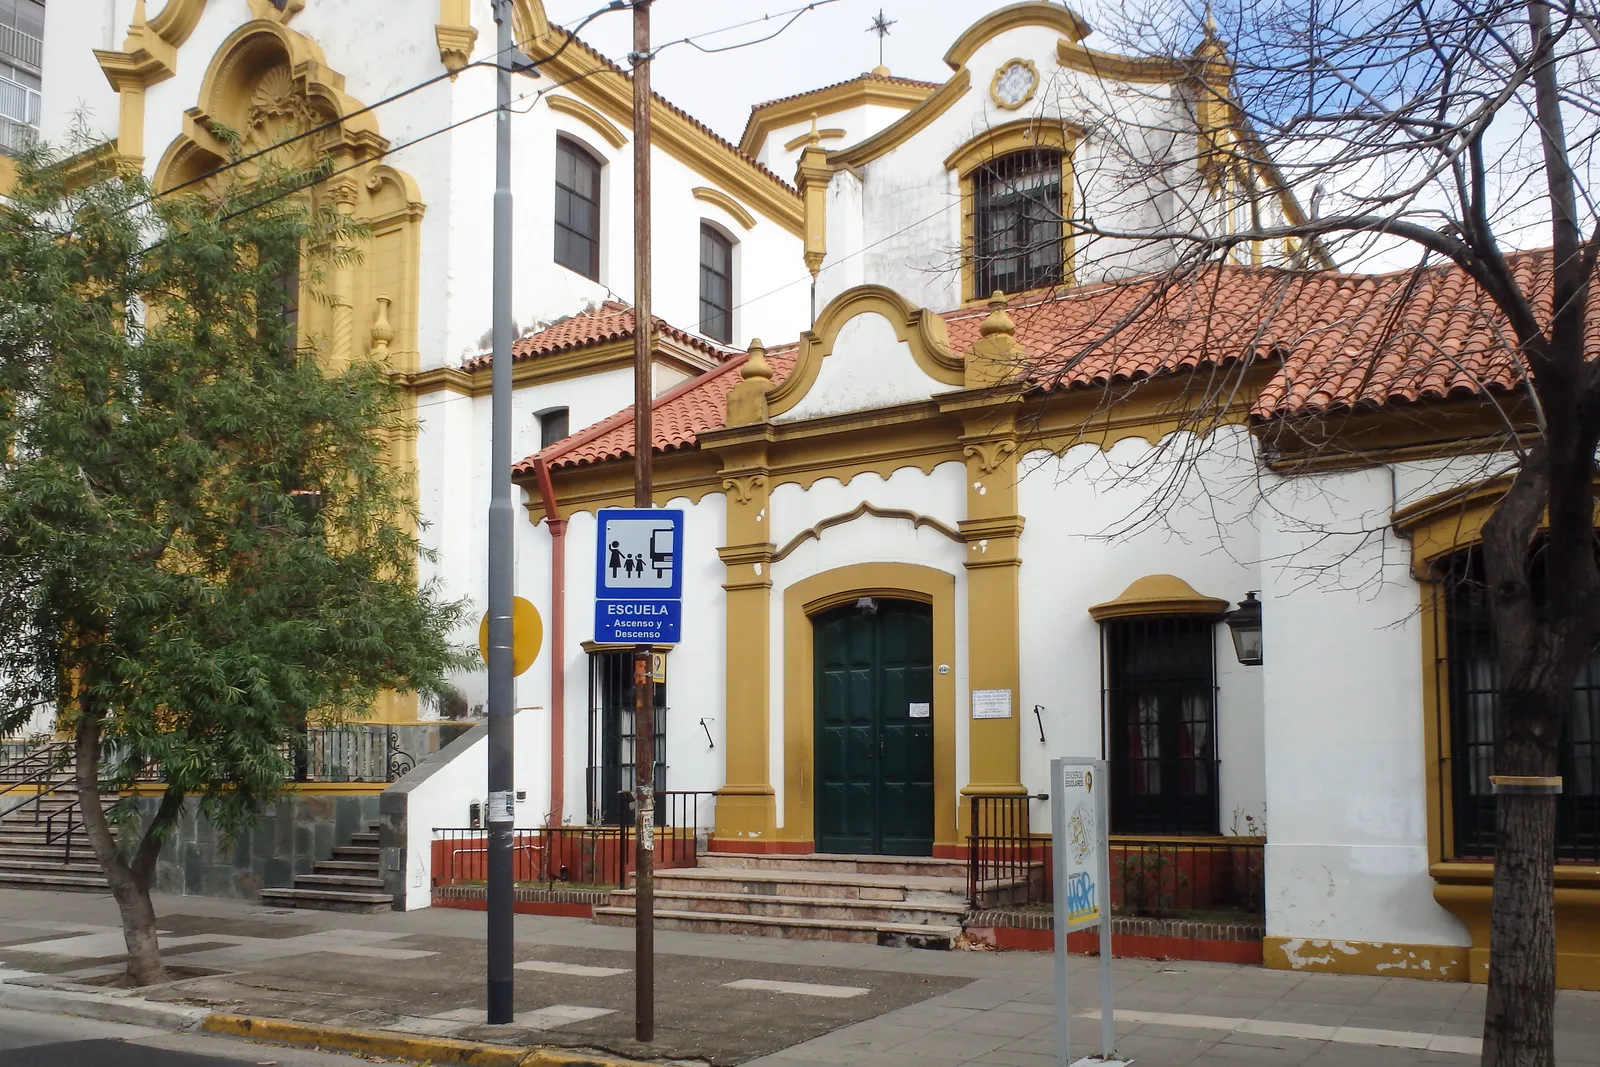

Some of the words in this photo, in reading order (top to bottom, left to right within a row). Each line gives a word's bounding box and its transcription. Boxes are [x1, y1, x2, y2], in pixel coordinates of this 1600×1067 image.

[607, 604, 668, 615] ESCUELA
[613, 619, 654, 627] Ascenso
[656, 621, 662, 629] y
[615, 630, 660, 638] Descenso
